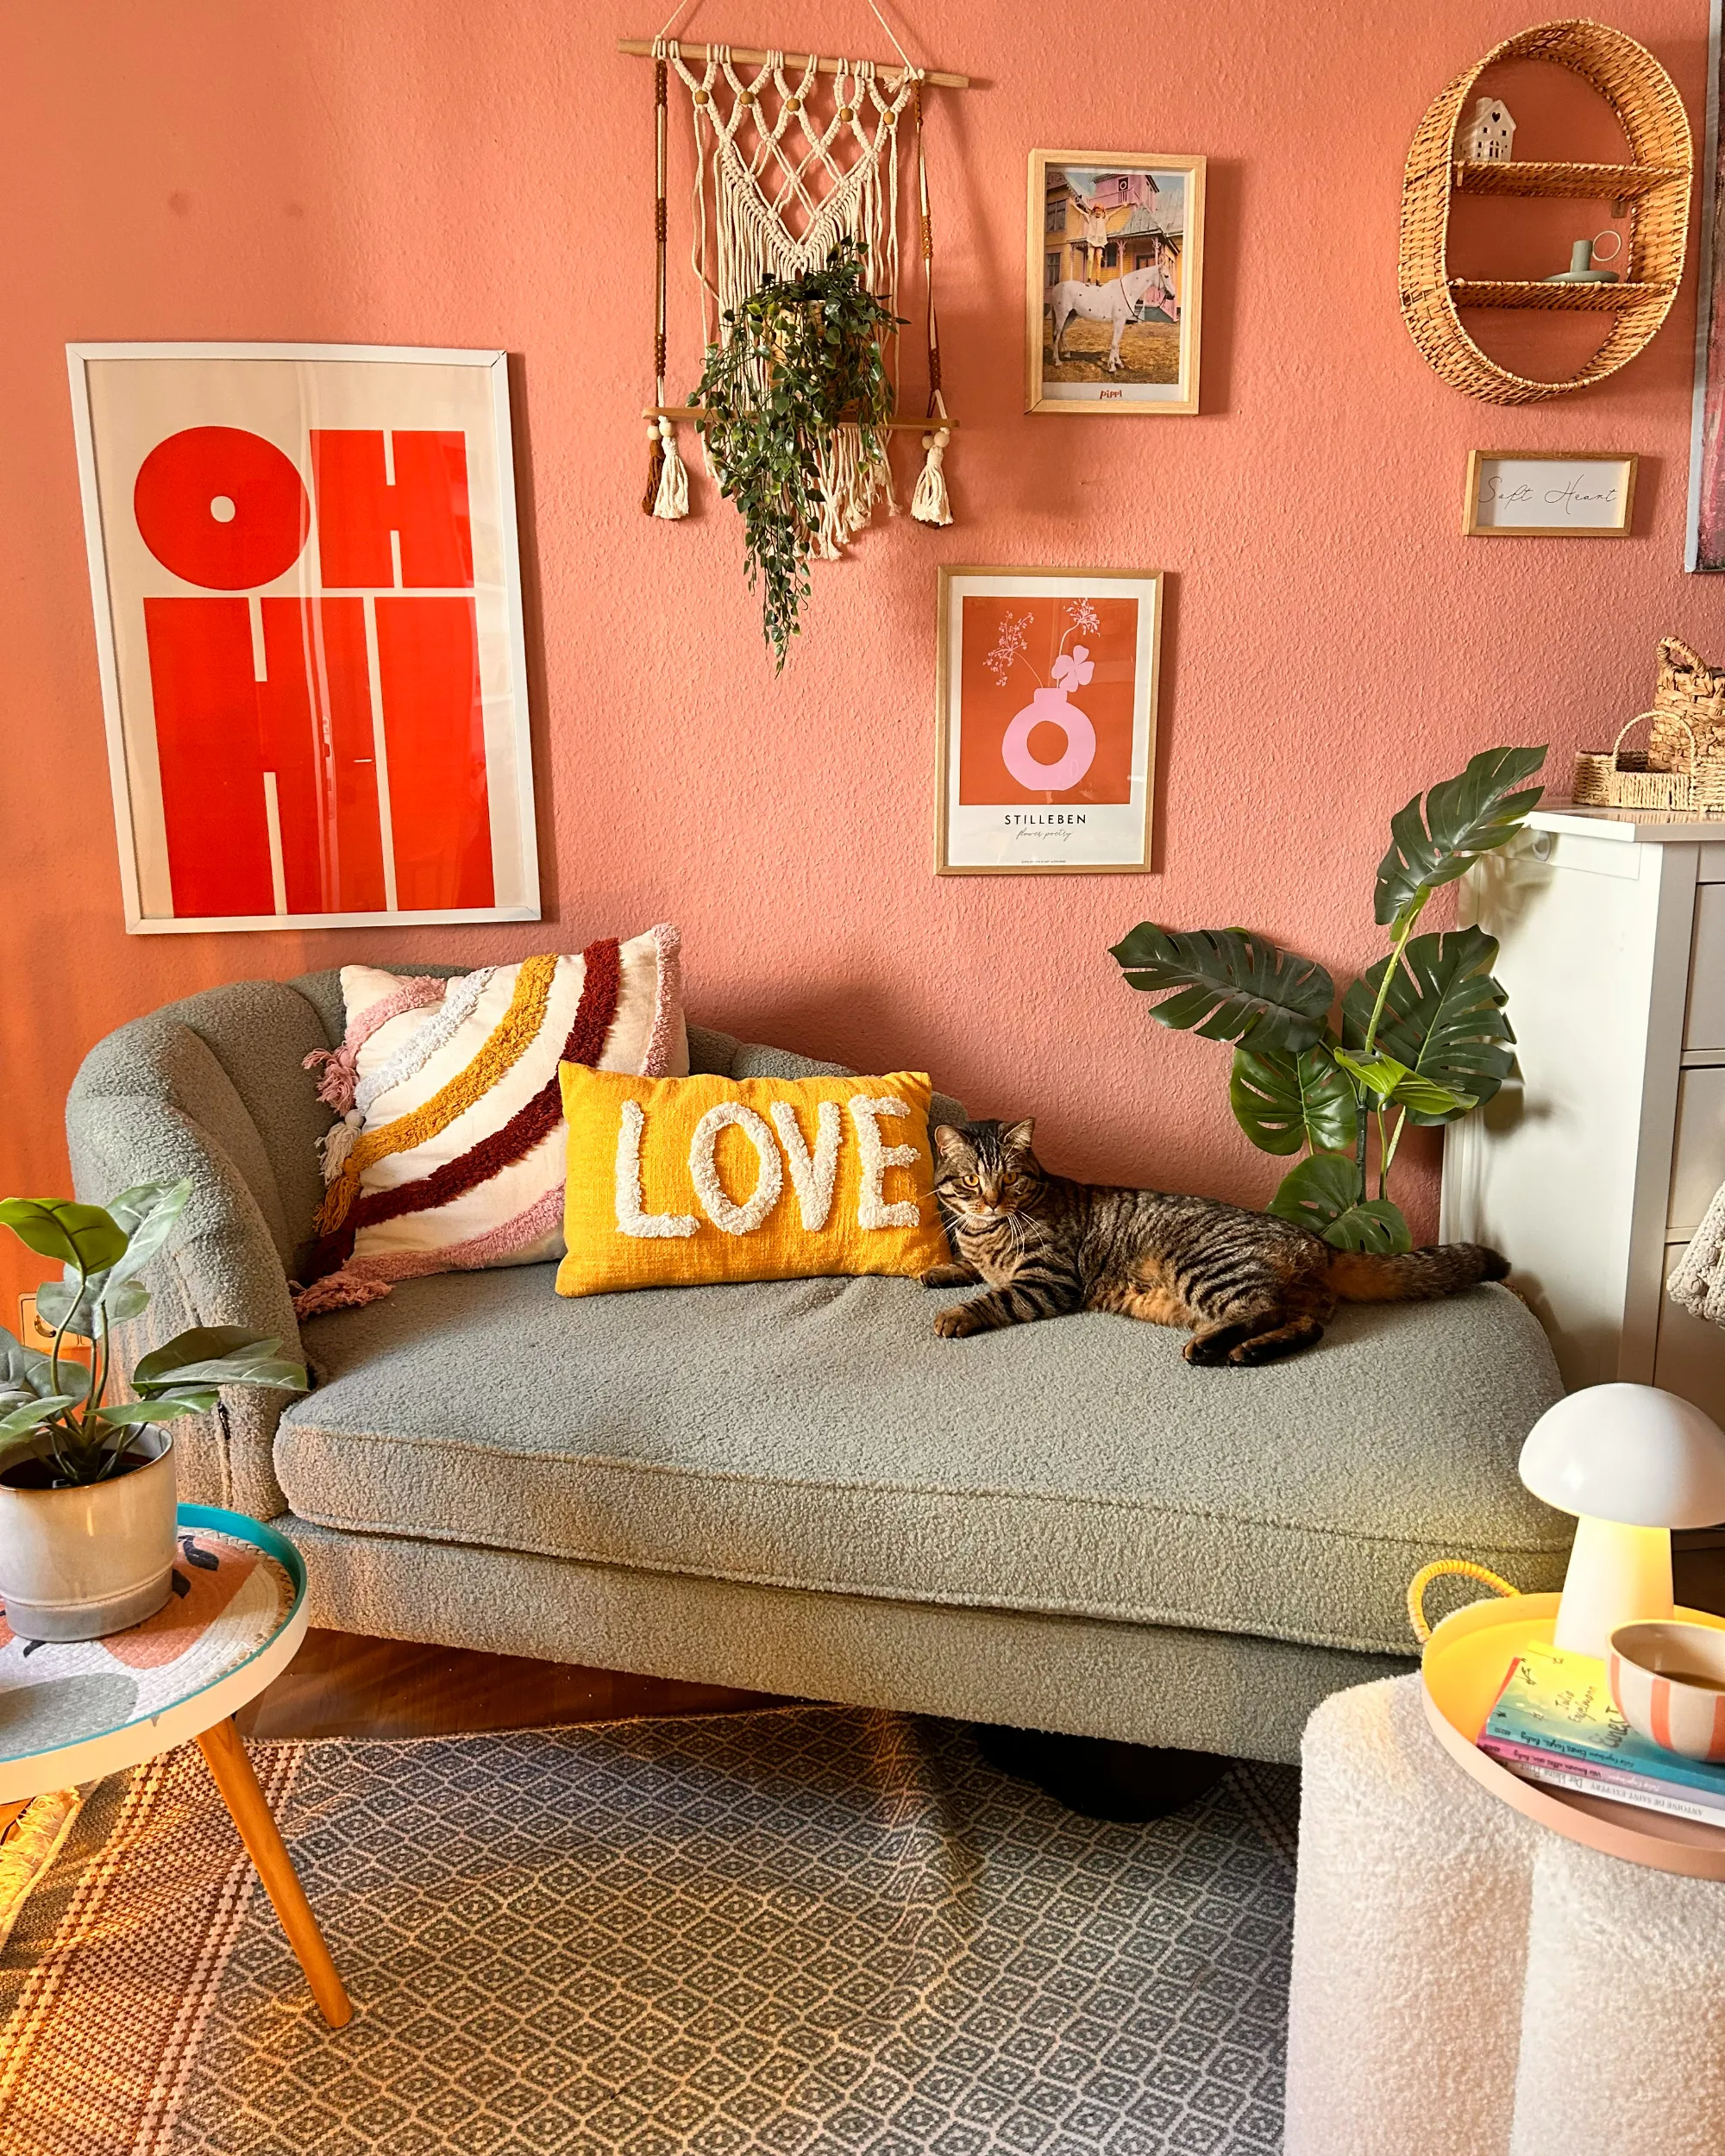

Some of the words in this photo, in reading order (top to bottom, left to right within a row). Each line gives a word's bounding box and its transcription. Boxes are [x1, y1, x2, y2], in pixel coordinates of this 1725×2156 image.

[1478, 476, 1534, 510] Soft
[1544, 473, 1618, 515] Heart
[133, 425, 474, 591] OH
[142, 596, 497, 918] HI
[1004, 814, 1087, 825] STILLEBEN
[1016, 827, 1043, 840] flower
[1043, 829, 1073, 842] poetry
[614, 1094, 922, 1238] LOVE
[1521, 1731, 1540, 1745] Baby
[1568, 1775, 1583, 1789] Der
[1628, 1793, 1652, 1804] SAINT
[1653, 1799, 1665, 1808] DE
